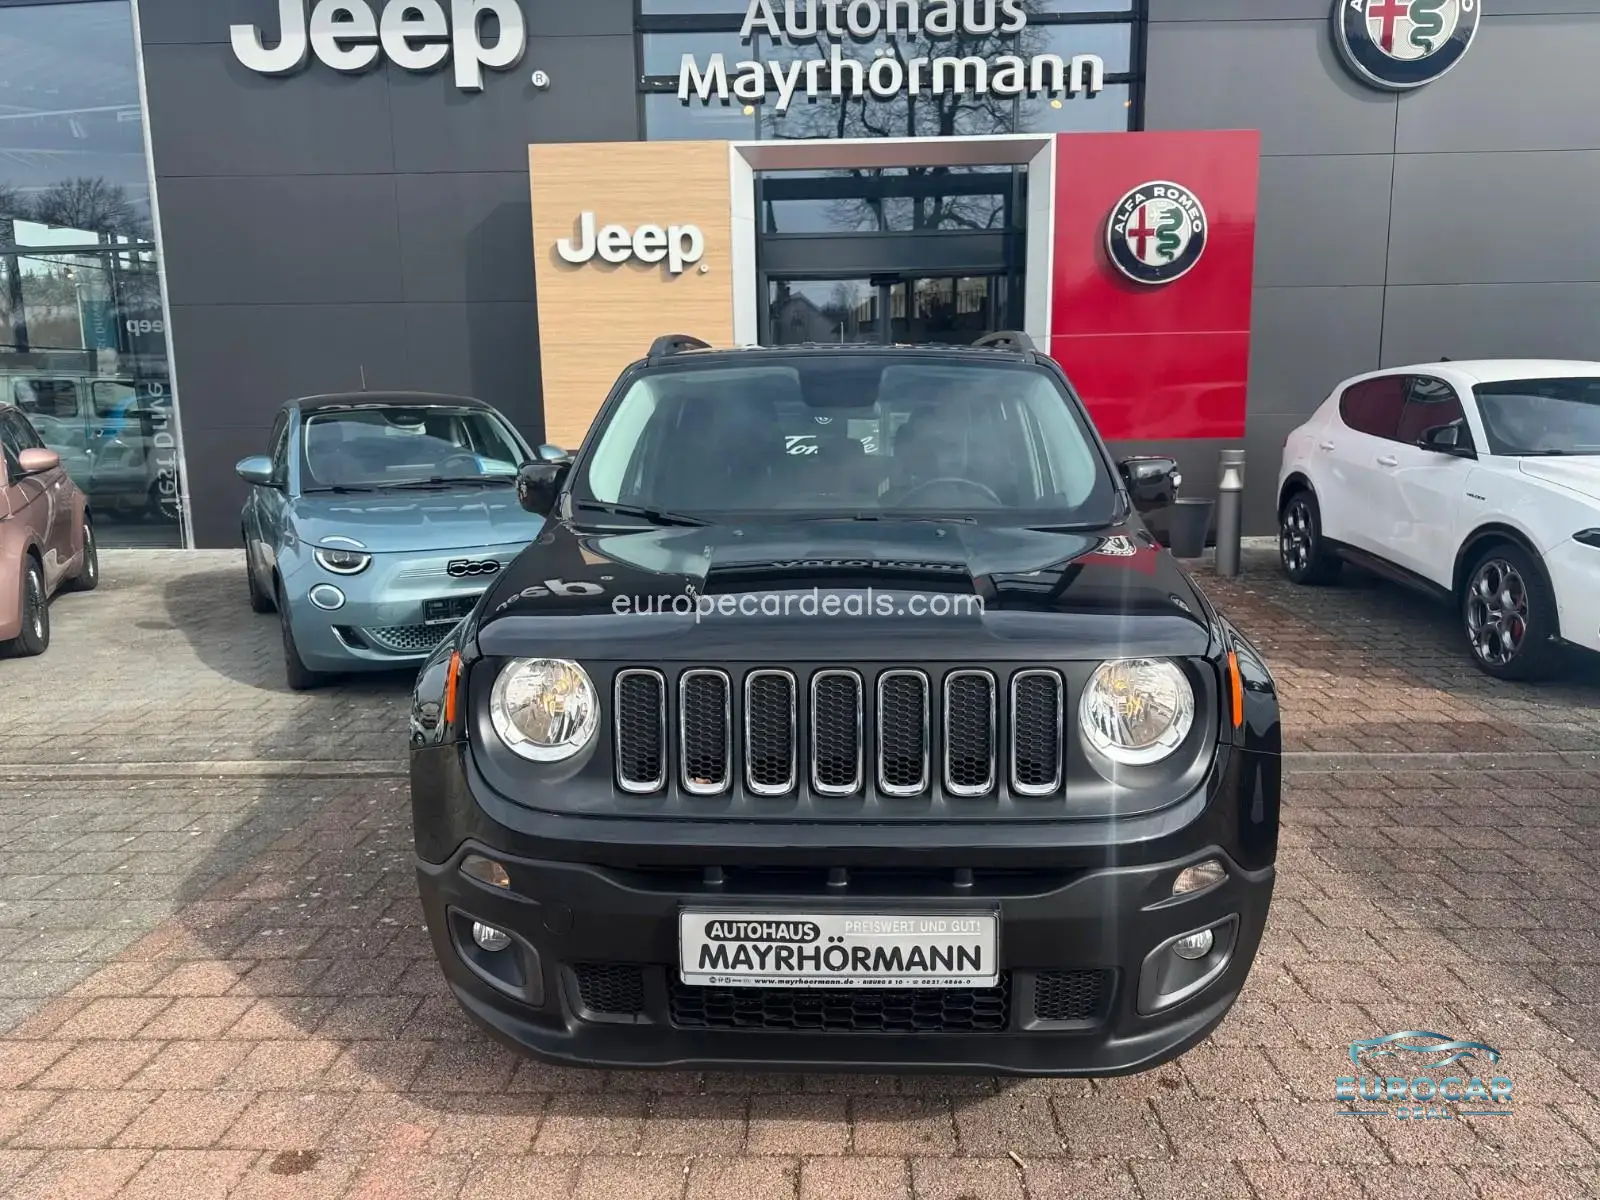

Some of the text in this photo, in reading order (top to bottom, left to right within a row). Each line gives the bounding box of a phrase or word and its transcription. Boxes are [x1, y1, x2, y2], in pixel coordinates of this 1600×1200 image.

[739, 0, 1028, 40] Autohaus
[230, 0, 526, 91] Jeep
[676, 44, 1105, 114] Mayrhörmann
[1114, 186, 1203, 234] ALFA ROMEO
[556, 210, 705, 273] Jeep
[447, 559, 500, 577] 500
[709, 919, 981, 940] AUTOHAUS PREISWERT UND GUT!
[698, 936, 981, 971] MAYRHÖRMANN
[754, 977, 854, 986] www.mayrhoermann.de
